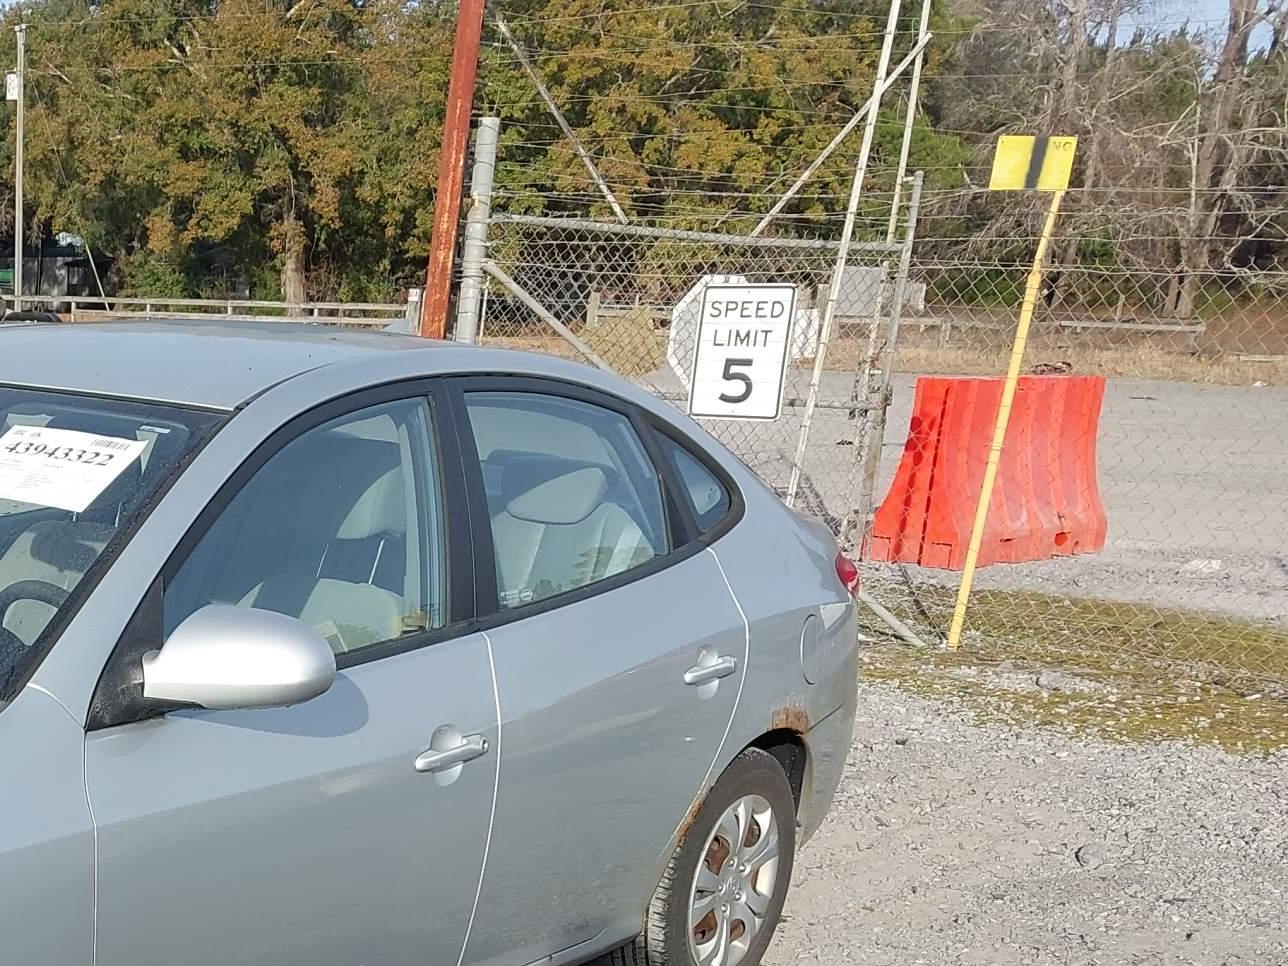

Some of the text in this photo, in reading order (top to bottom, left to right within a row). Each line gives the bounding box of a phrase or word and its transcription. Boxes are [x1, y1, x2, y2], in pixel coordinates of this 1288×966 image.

[709, 300, 785, 318] SPEED
[712, 329, 774, 347] LIMIT
[718, 358, 754, 404] 5
[5, 440, 114, 466] 43943322
